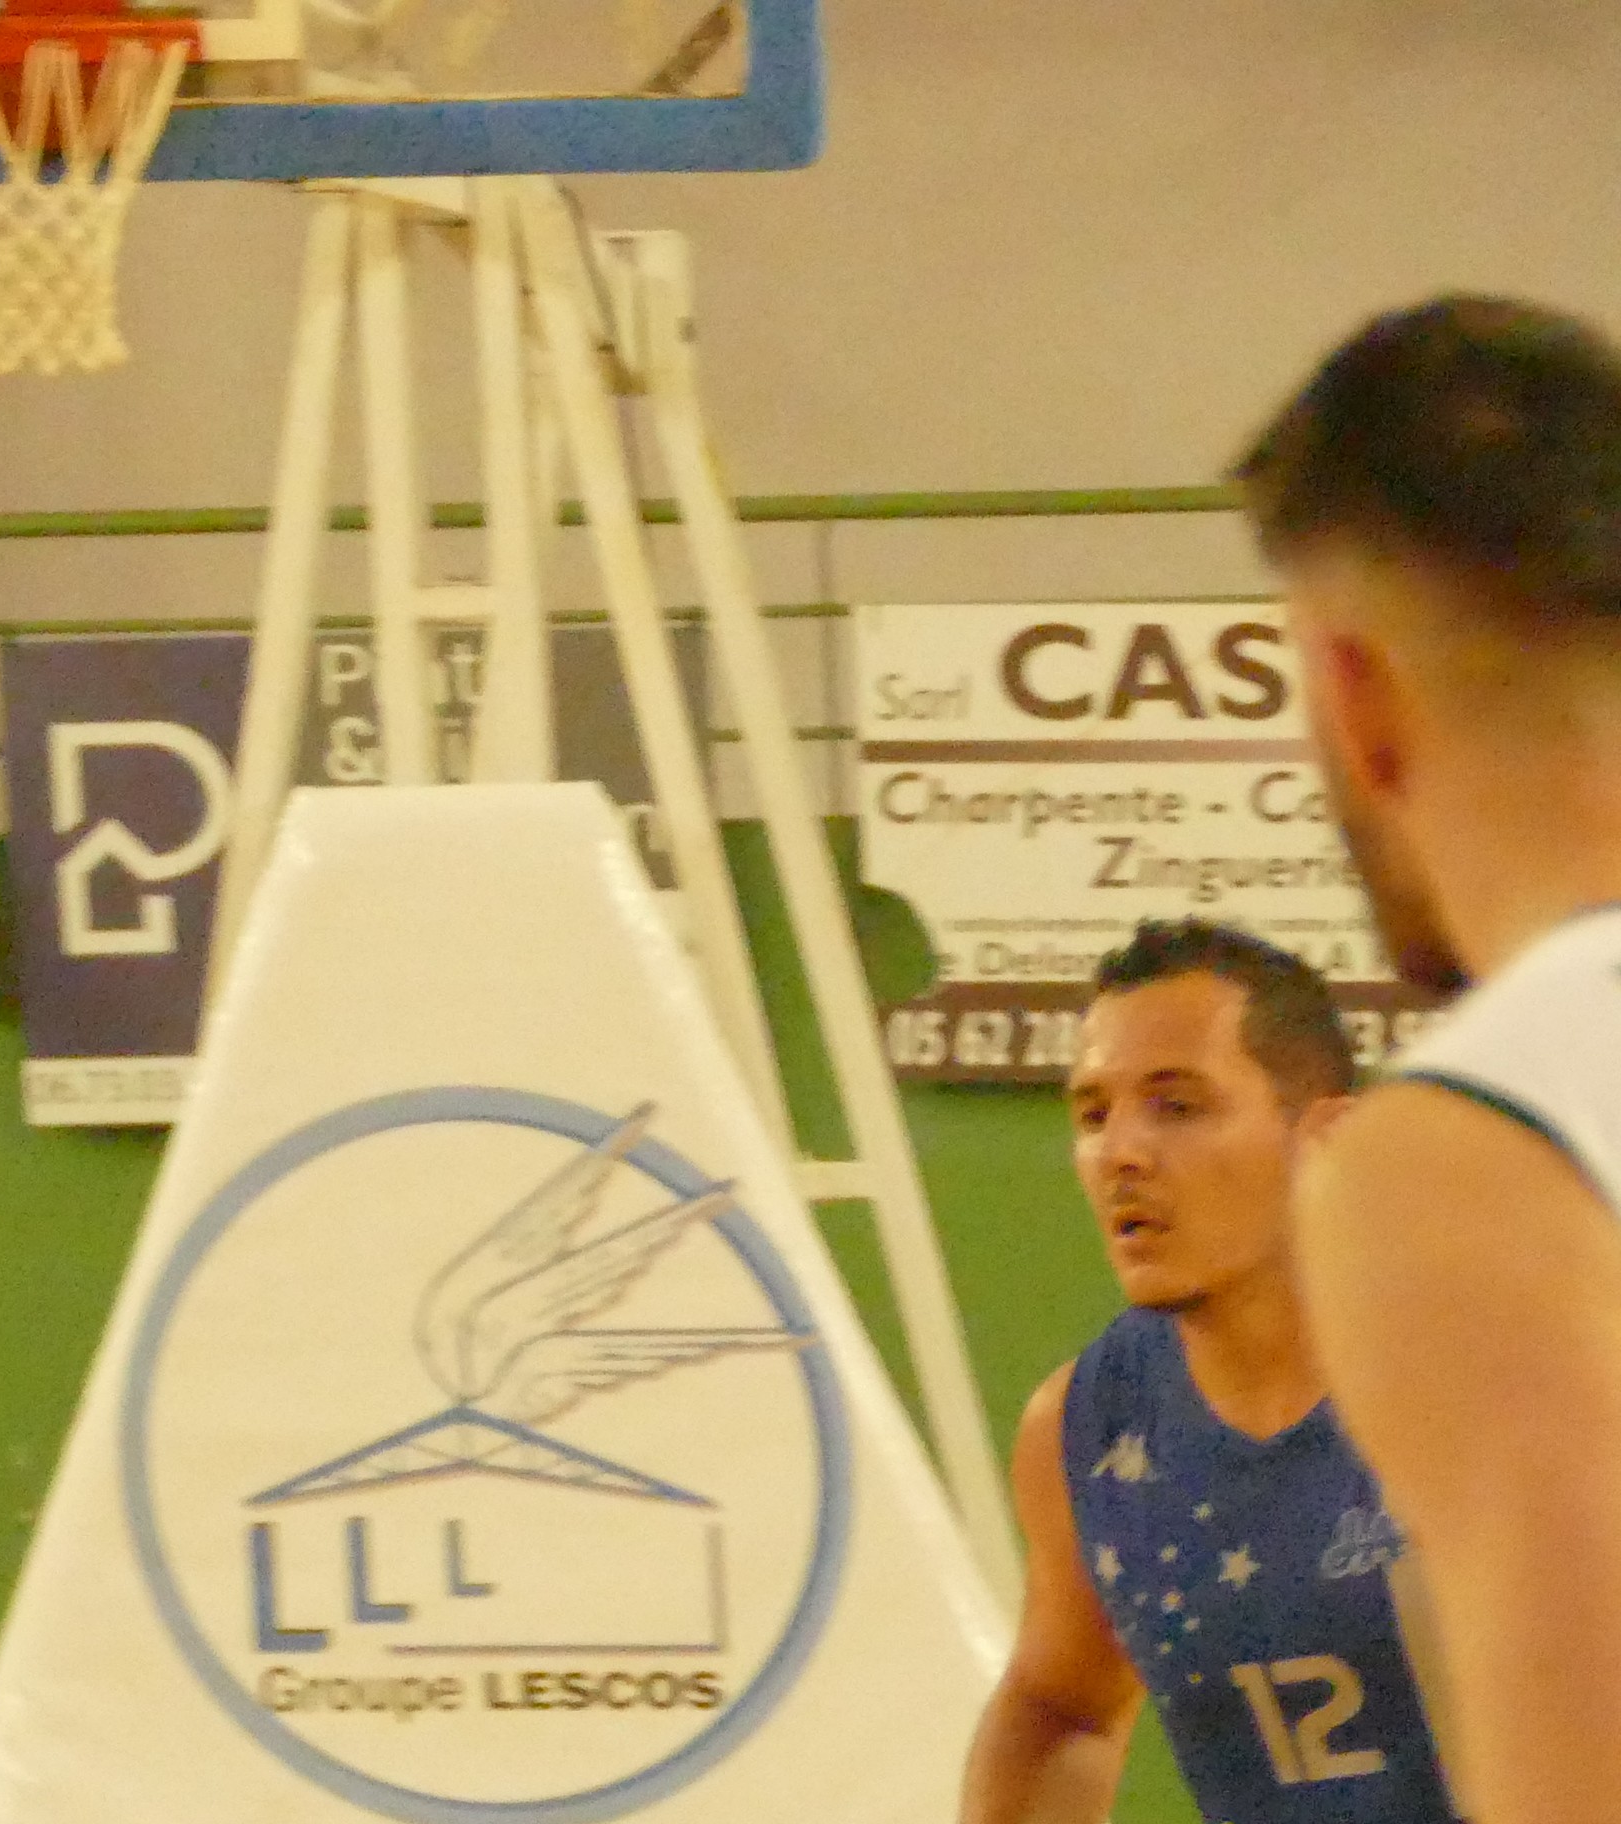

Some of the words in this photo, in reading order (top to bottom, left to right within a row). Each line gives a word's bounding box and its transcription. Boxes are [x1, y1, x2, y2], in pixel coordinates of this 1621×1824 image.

[876, 770, 1185, 838] Charpente
[258, 1667, 466, 1720] Groupe
[484, 1671, 724, 1713] LESCOS
[1230, 1653, 1388, 1786] 12
